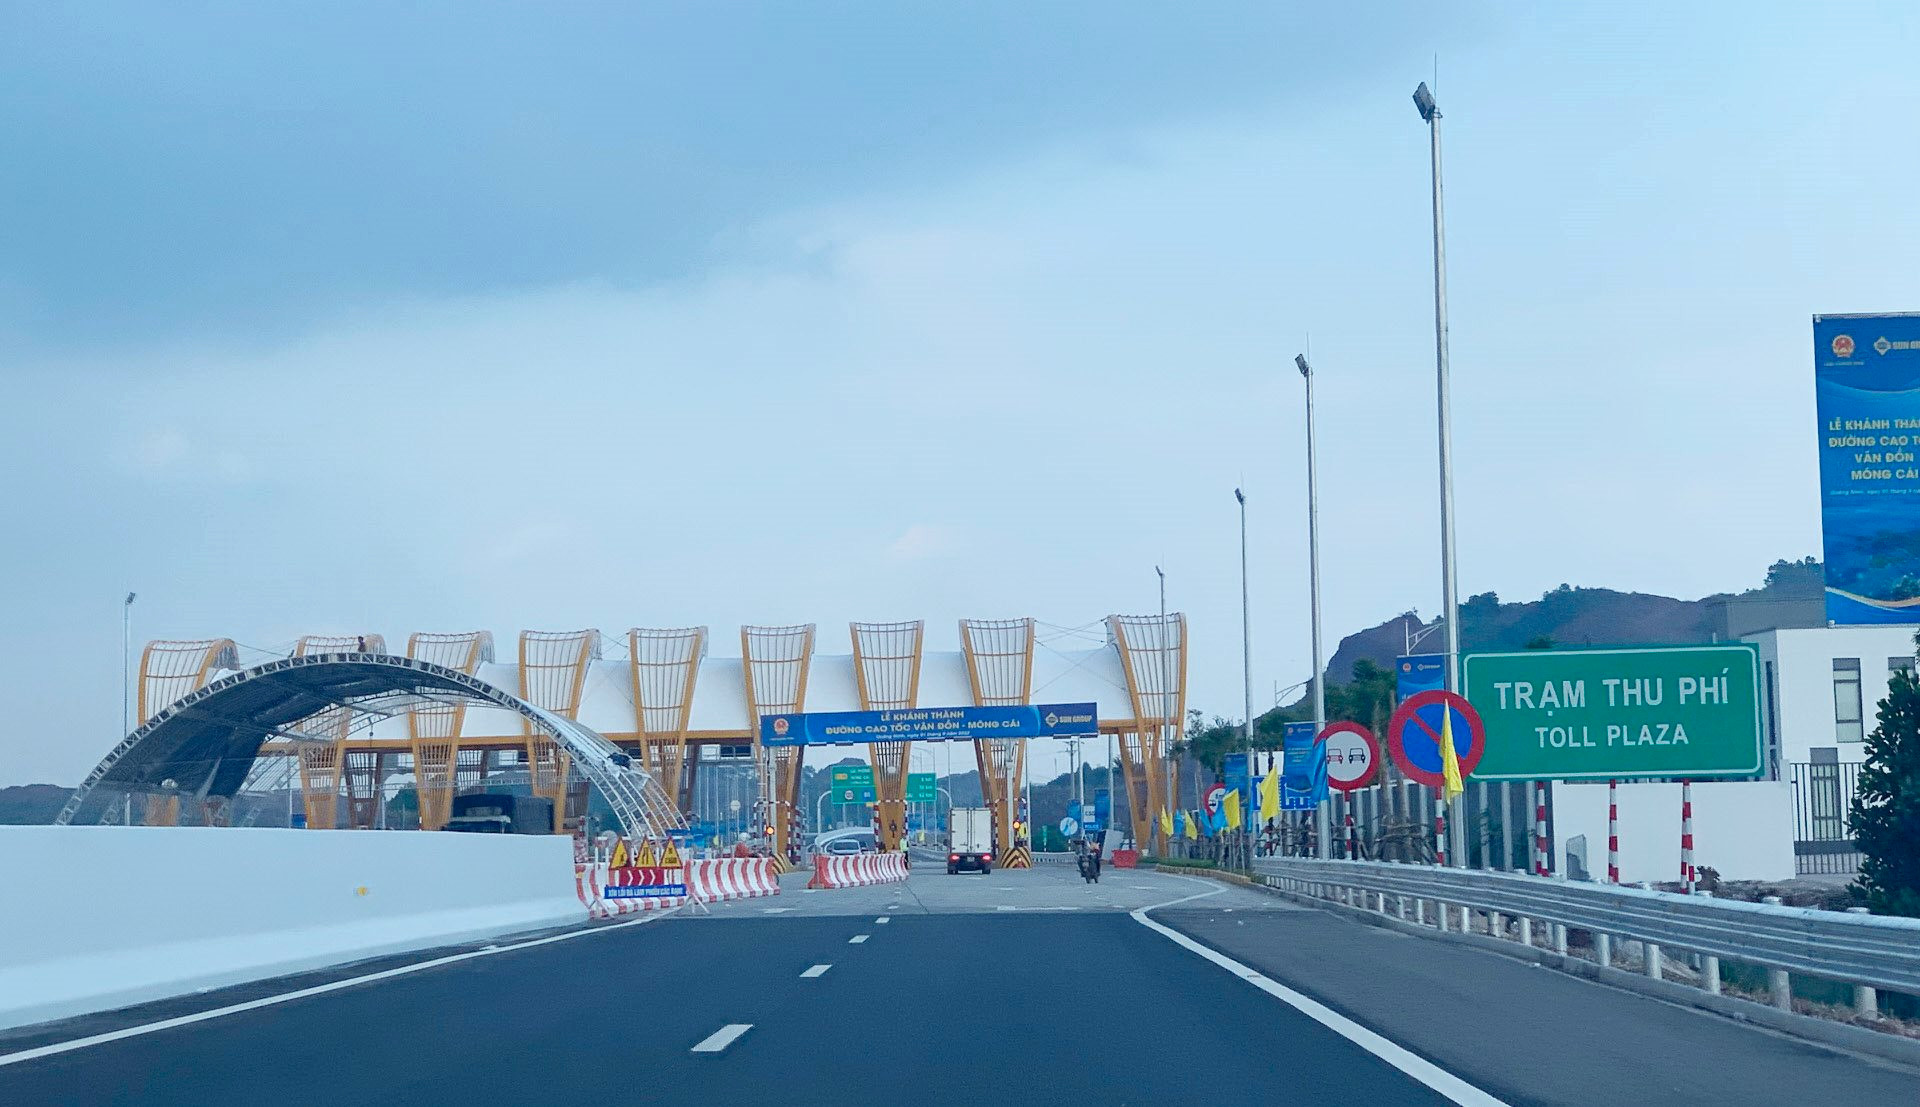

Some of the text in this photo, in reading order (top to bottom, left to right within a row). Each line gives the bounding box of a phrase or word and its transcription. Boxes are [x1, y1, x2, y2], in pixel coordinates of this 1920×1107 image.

[1829, 416, 1841, 431] LỄ
[1845, 416, 1890, 431] KHÁNH
[1828, 433, 1876, 448] ĐƯỜNG
[1880, 434, 1909, 446] CAO
[1851, 466, 1919, 480] MÓNG CÁI
[1493, 667, 1729, 717] TRẠM THU PHÍ
[893, 711, 928, 721] KHÁNH
[930, 709, 964, 720] THÀNH
[825, 724, 862, 735] ĐƯỜNG
[865, 725, 887, 733] CAO
[890, 721, 910, 732] TỐC
[937, 719, 960, 730] ĐỒN
[968, 719, 999, 729] MÓNG
[1001, 718, 1020, 728] CÁI
[1535, 723, 1690, 748] TOLL PLAZA
